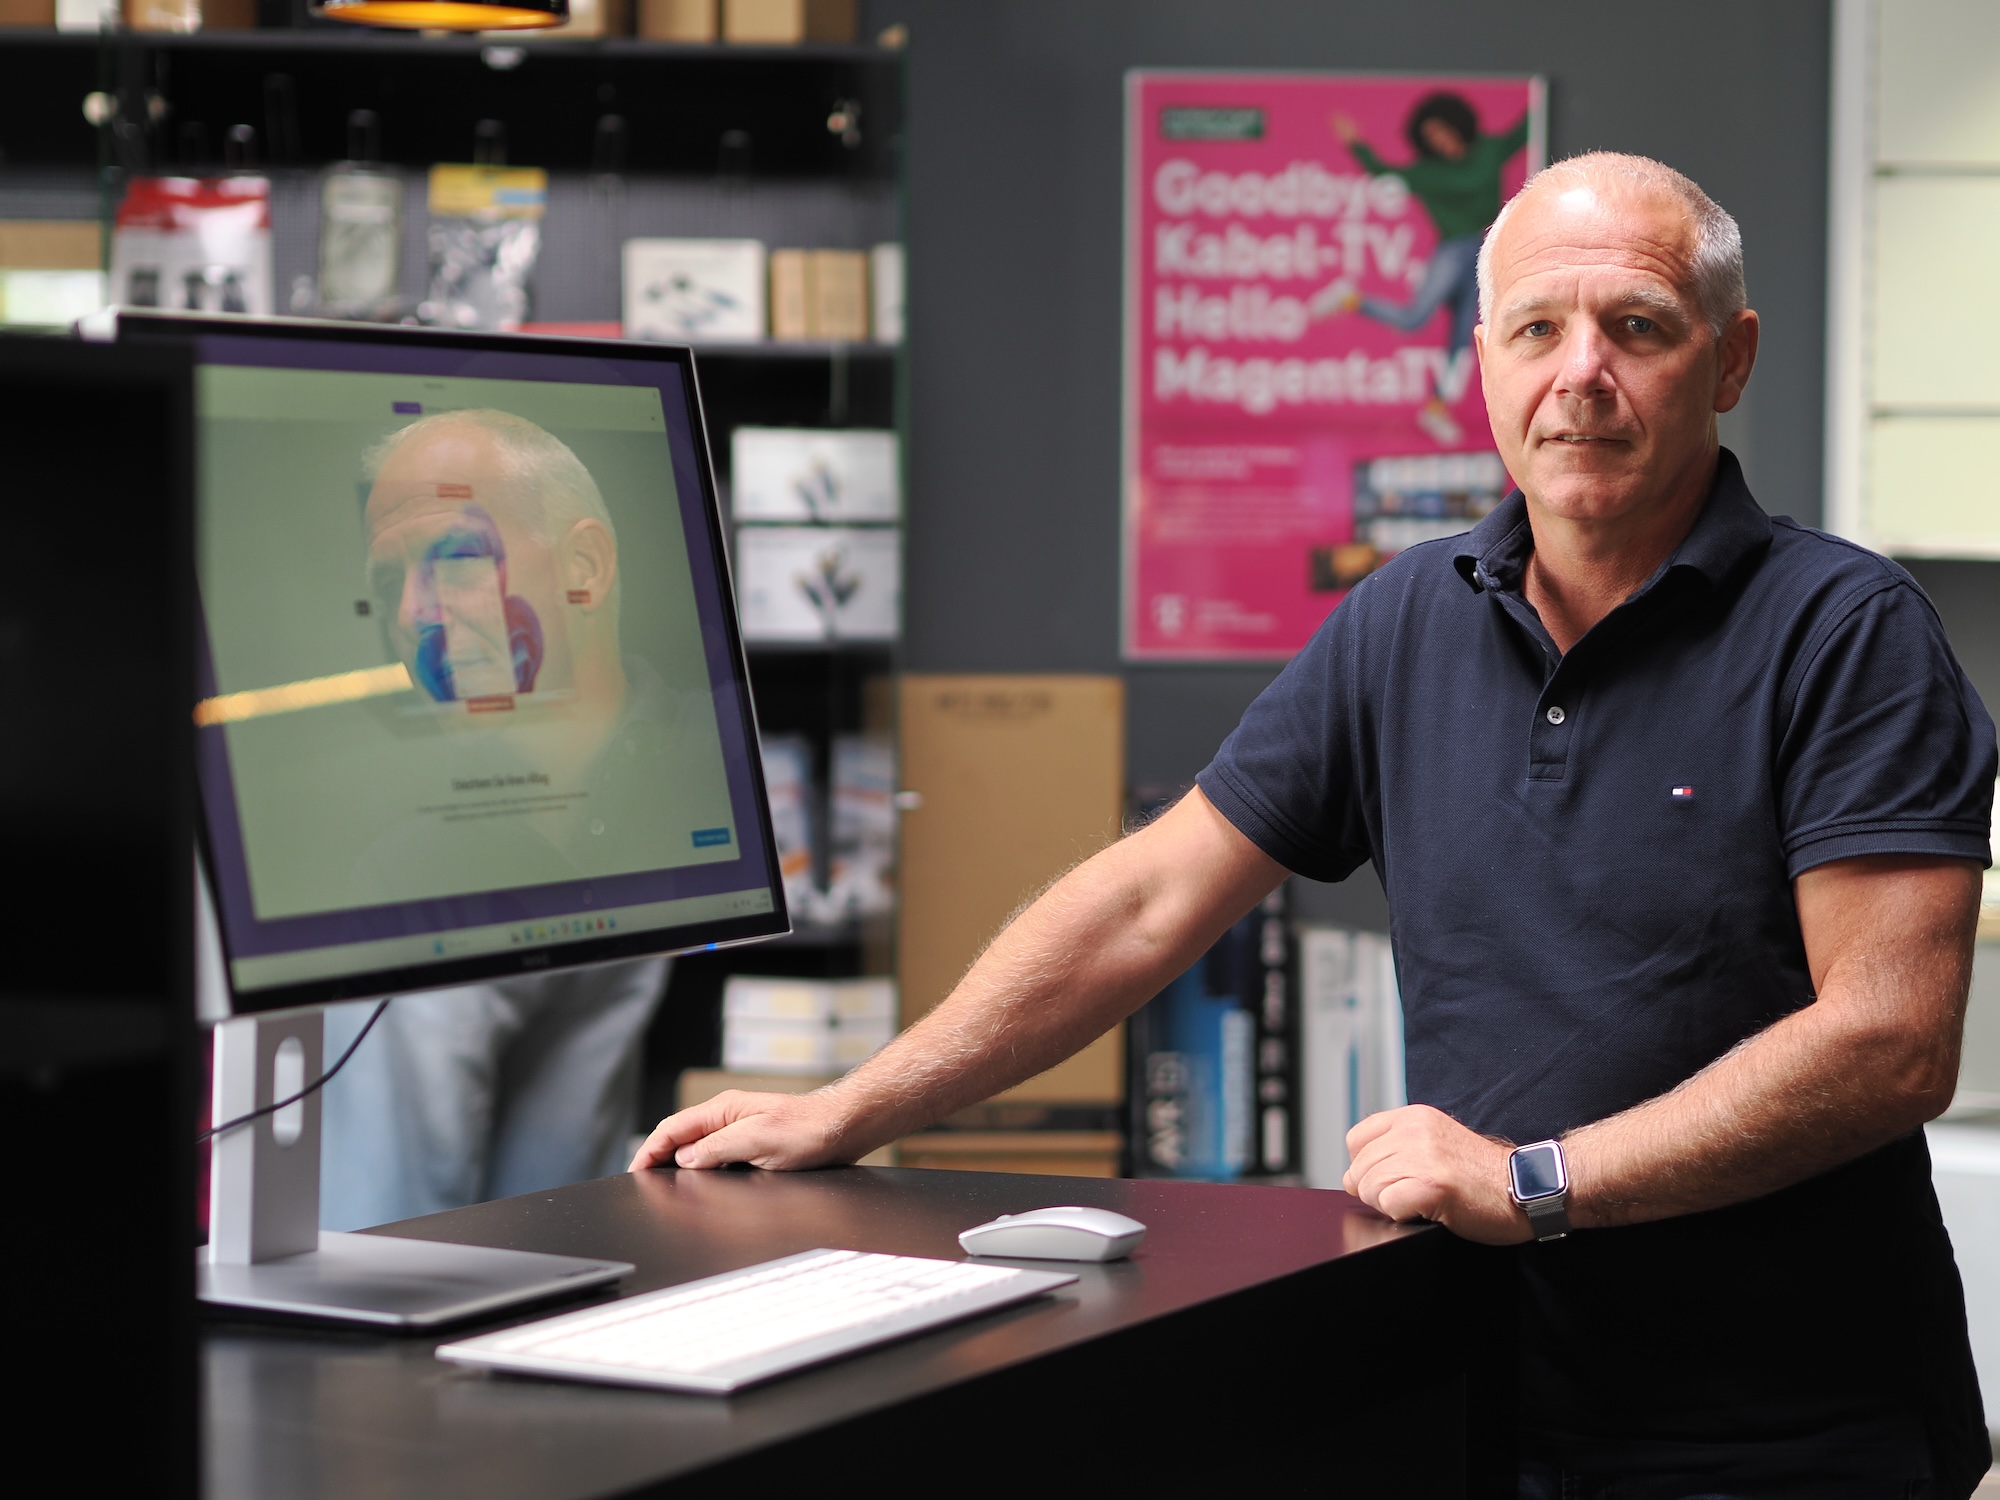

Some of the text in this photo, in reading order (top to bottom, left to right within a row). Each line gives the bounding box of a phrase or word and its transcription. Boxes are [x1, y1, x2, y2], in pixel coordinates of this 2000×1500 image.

[1155, 159, 1408, 229] Goodbye
[1155, 222, 1425, 282] Kabel-TV,
[1155, 286, 1307, 341] Hello
[1155, 347, 1473, 414] MagentaTV
